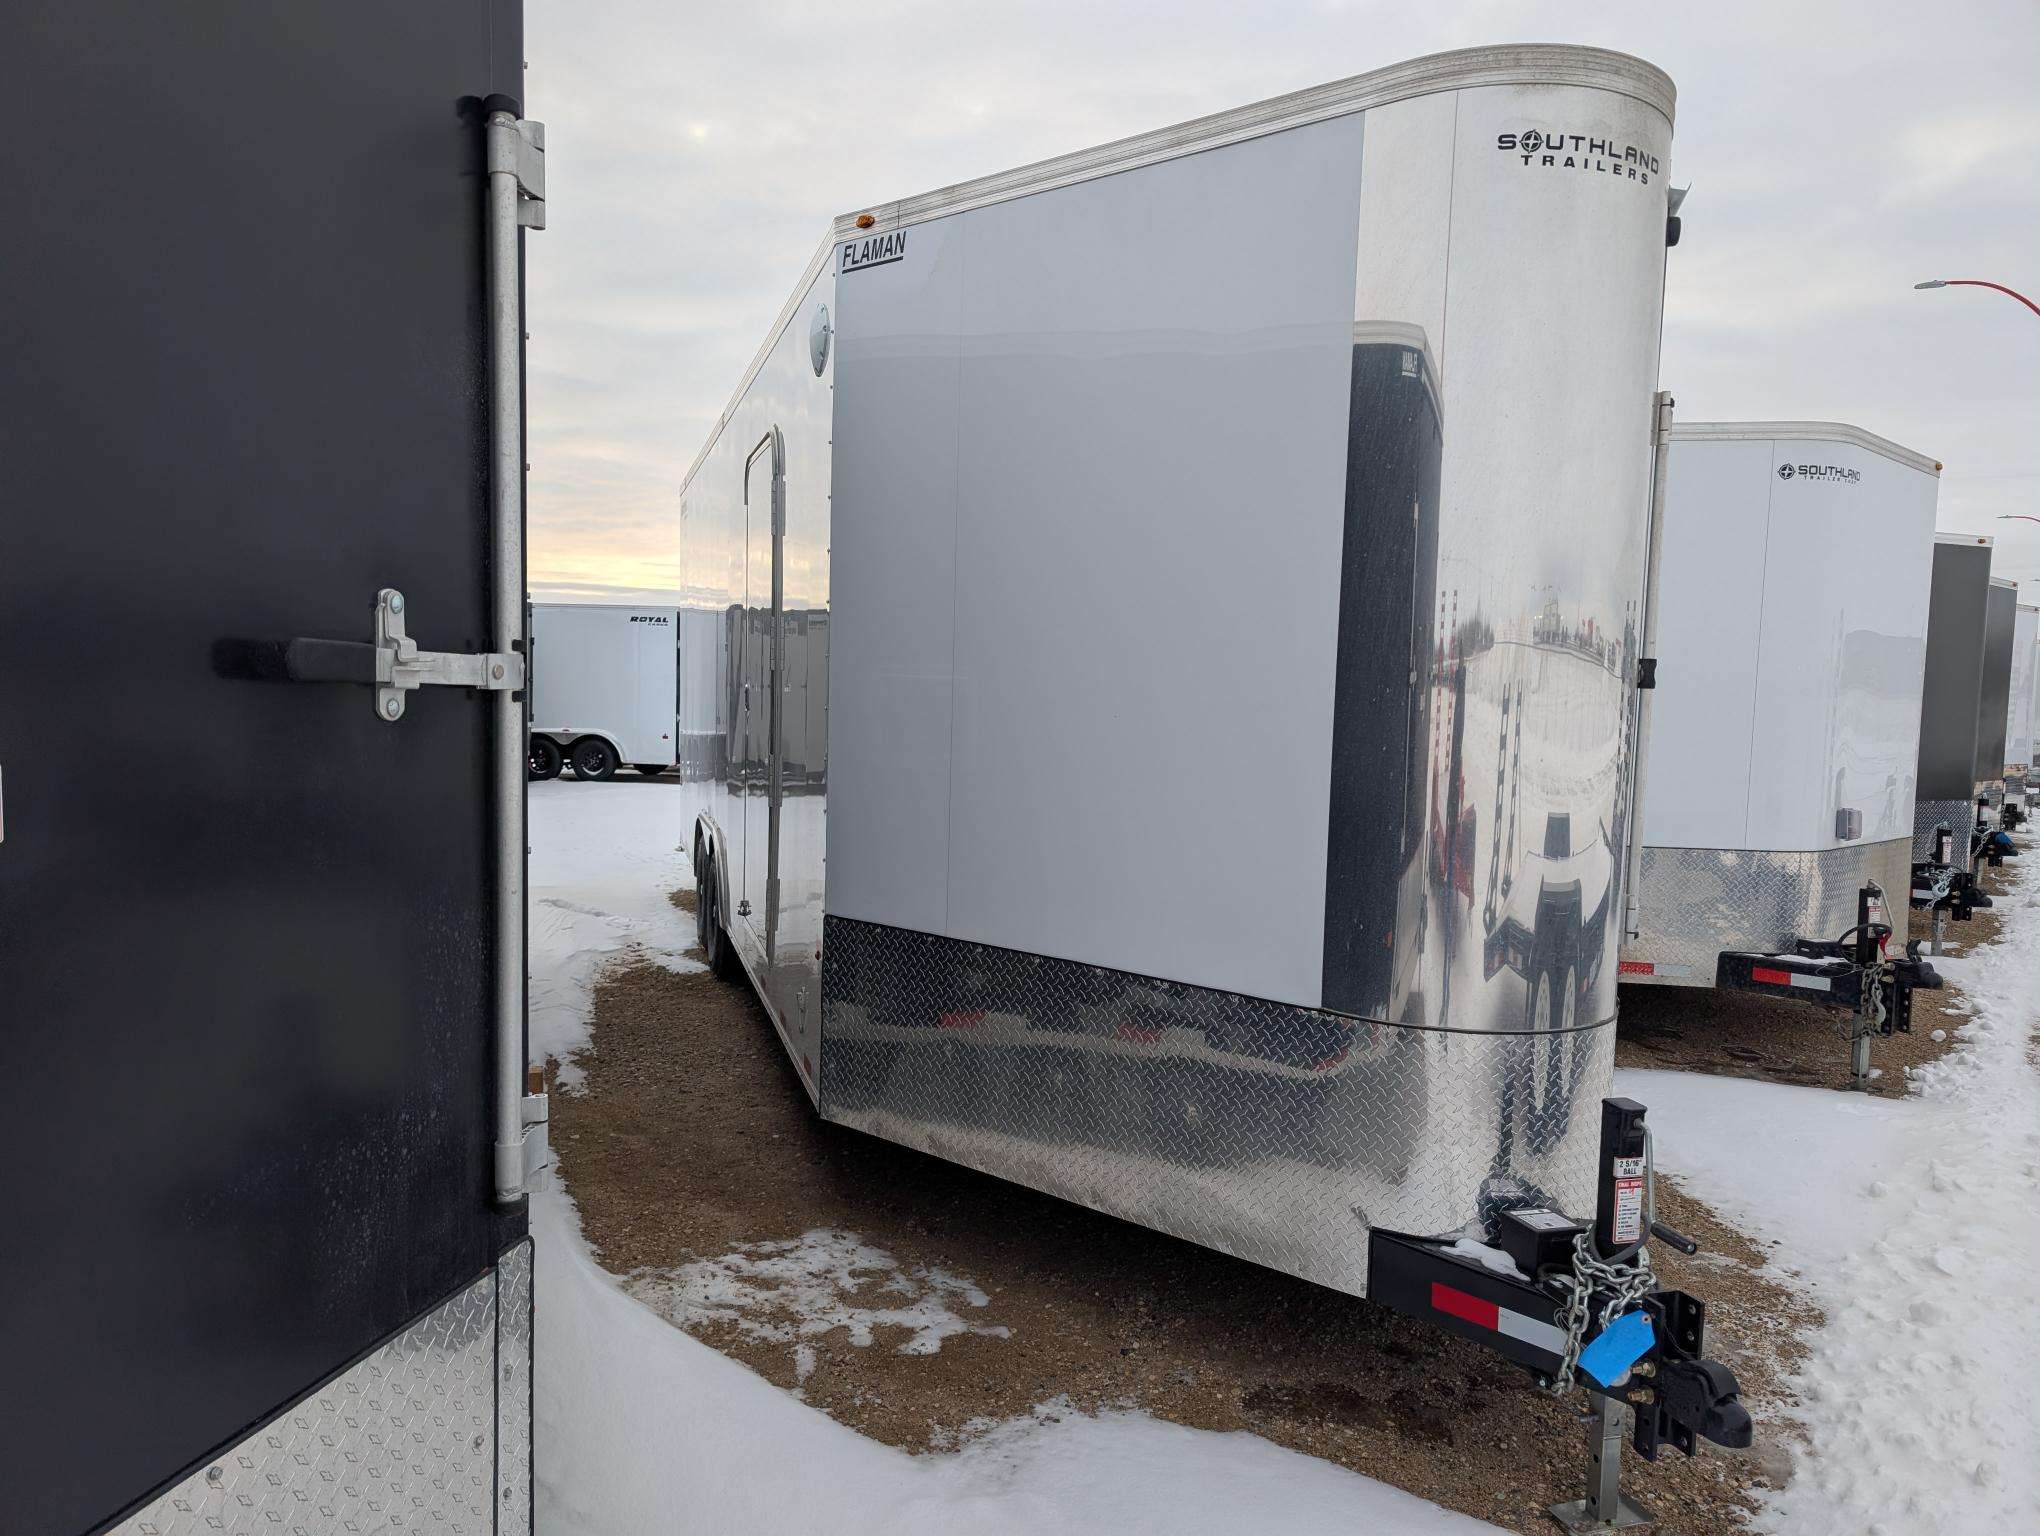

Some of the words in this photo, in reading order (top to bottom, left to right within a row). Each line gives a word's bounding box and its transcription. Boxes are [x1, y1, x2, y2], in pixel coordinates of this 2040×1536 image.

[1497, 129, 1660, 175] SOUTHLAND
[1520, 154, 1649, 185] TRAILERS
[842, 231, 907, 268] FLAMAN
[1798, 465, 1861, 481] SOUTHLAND
